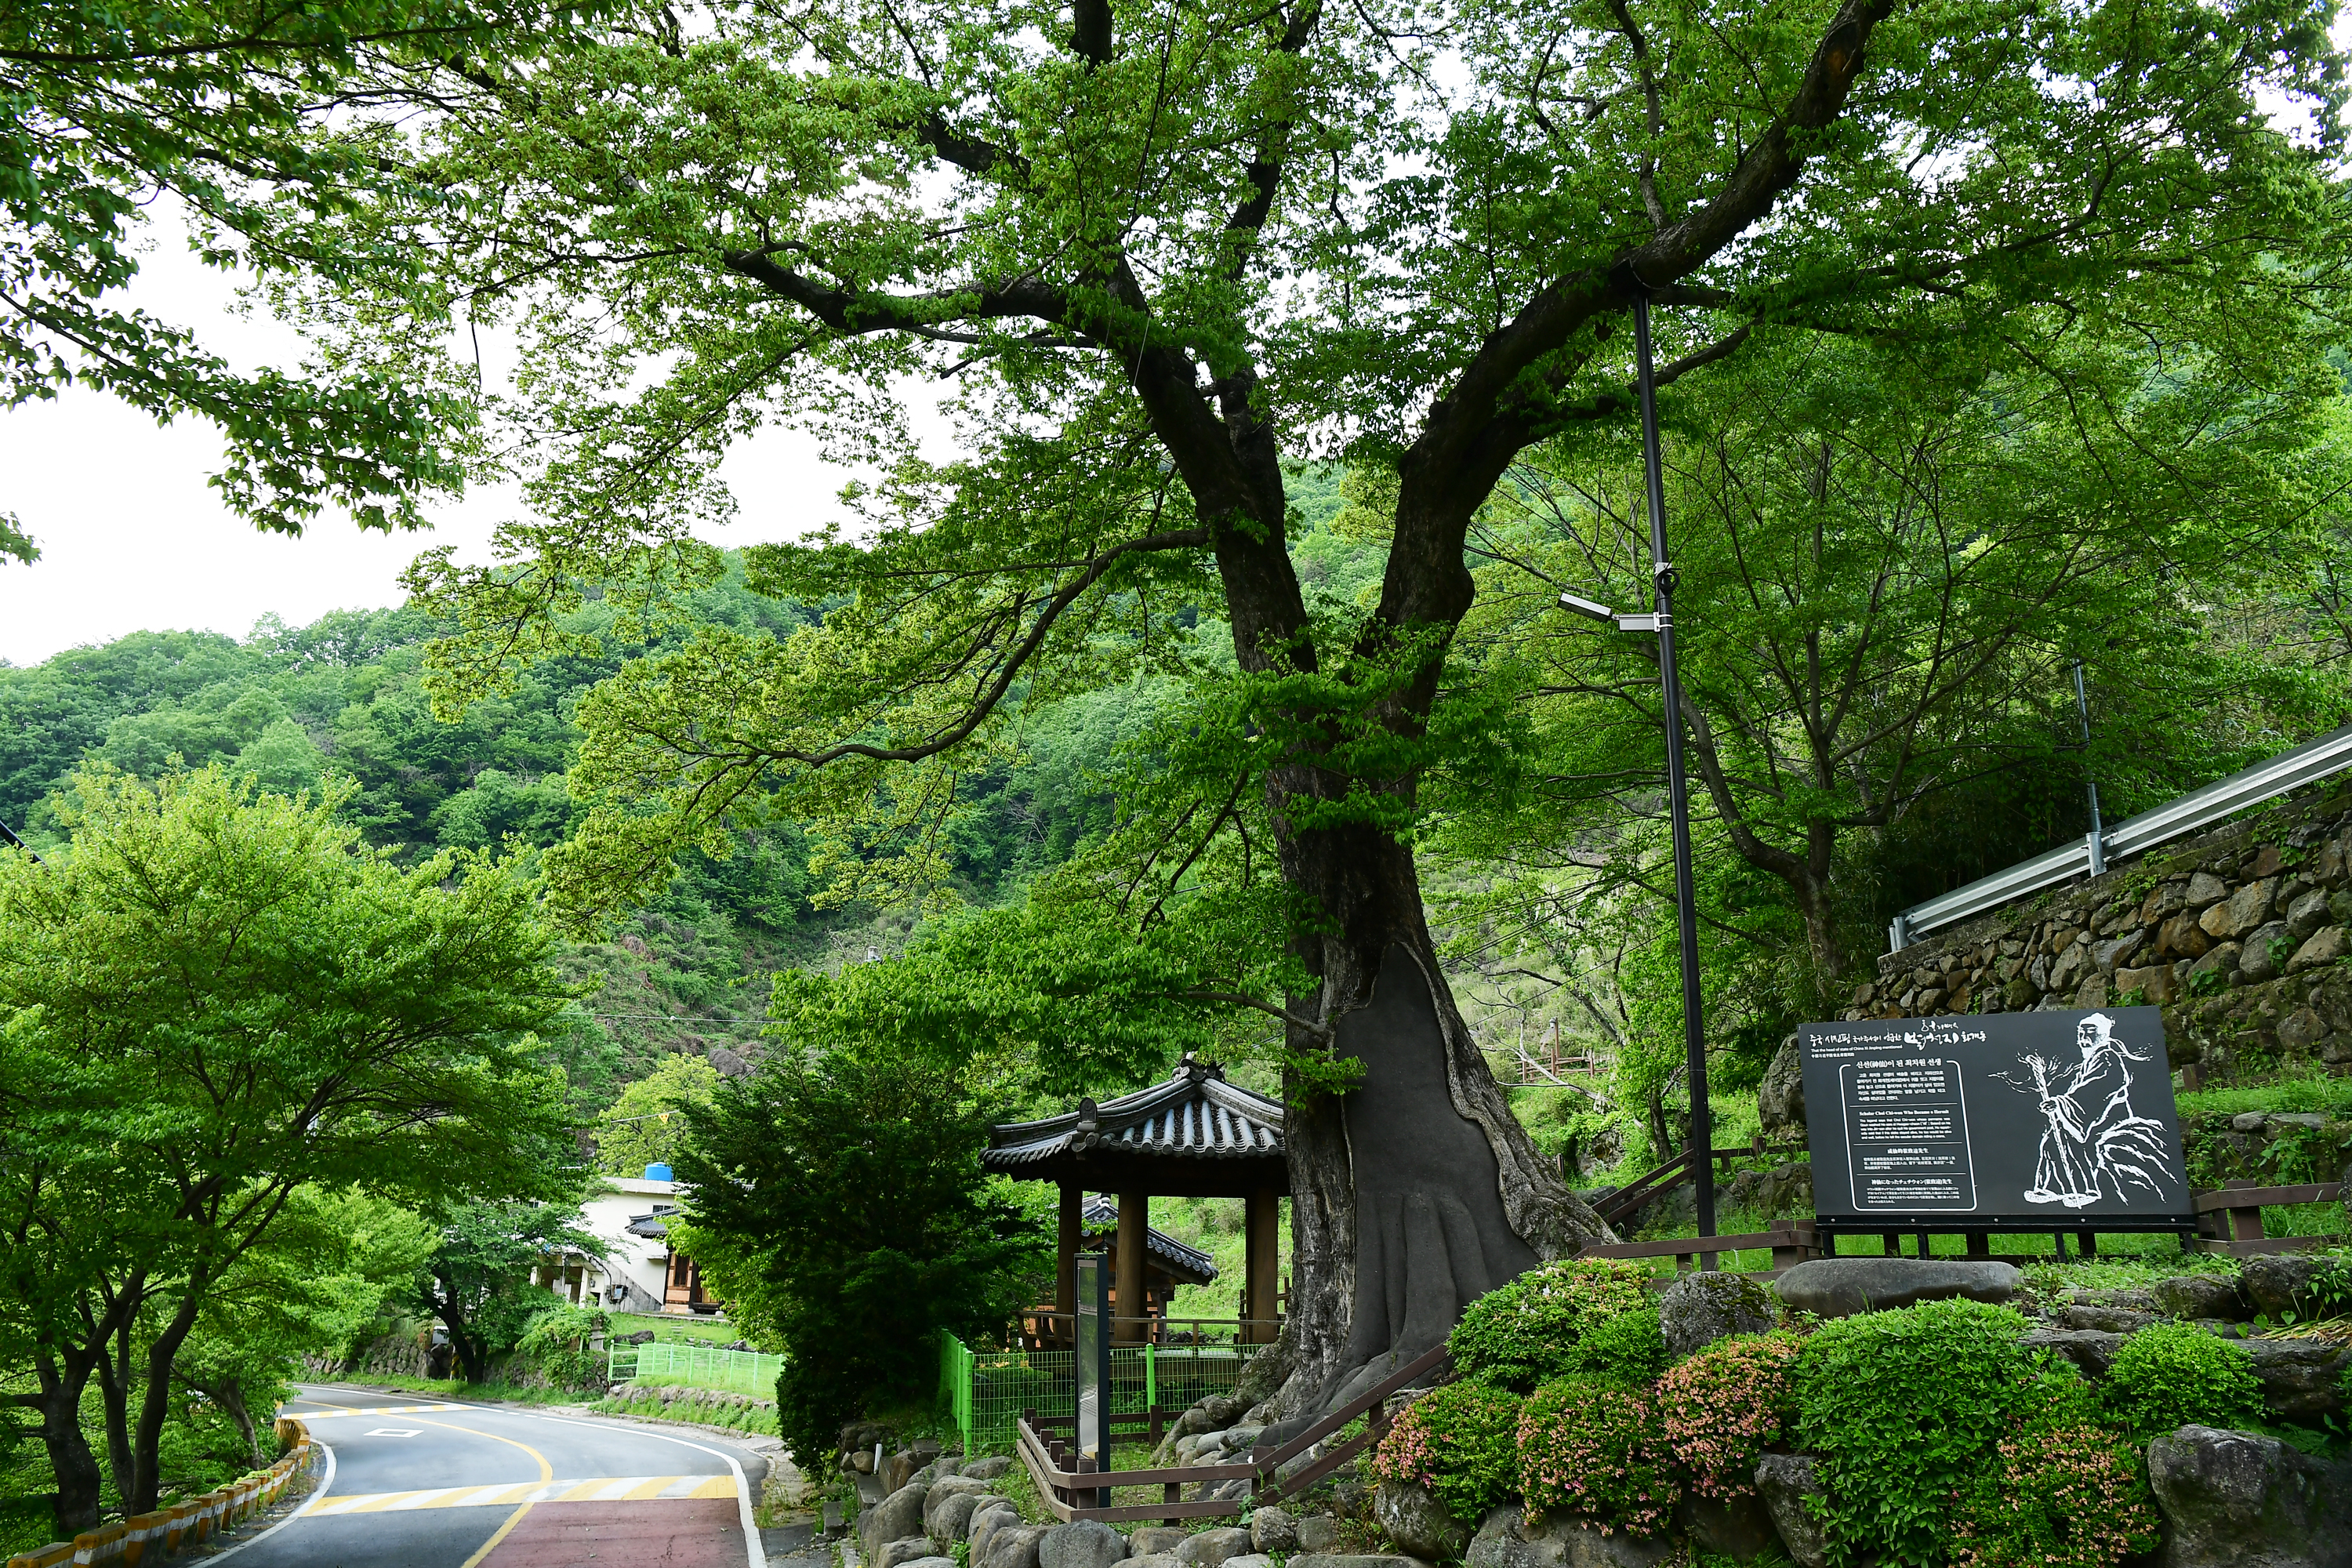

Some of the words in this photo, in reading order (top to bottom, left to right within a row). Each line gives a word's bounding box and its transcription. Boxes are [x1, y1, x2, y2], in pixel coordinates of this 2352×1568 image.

[1809, 1033, 1823, 1047] 중국
[1825, 1033, 1851, 1044] 시진핑
[1904, 1032, 1959, 1051] 별천지
[1961, 1031, 1987, 1042] 화개동
